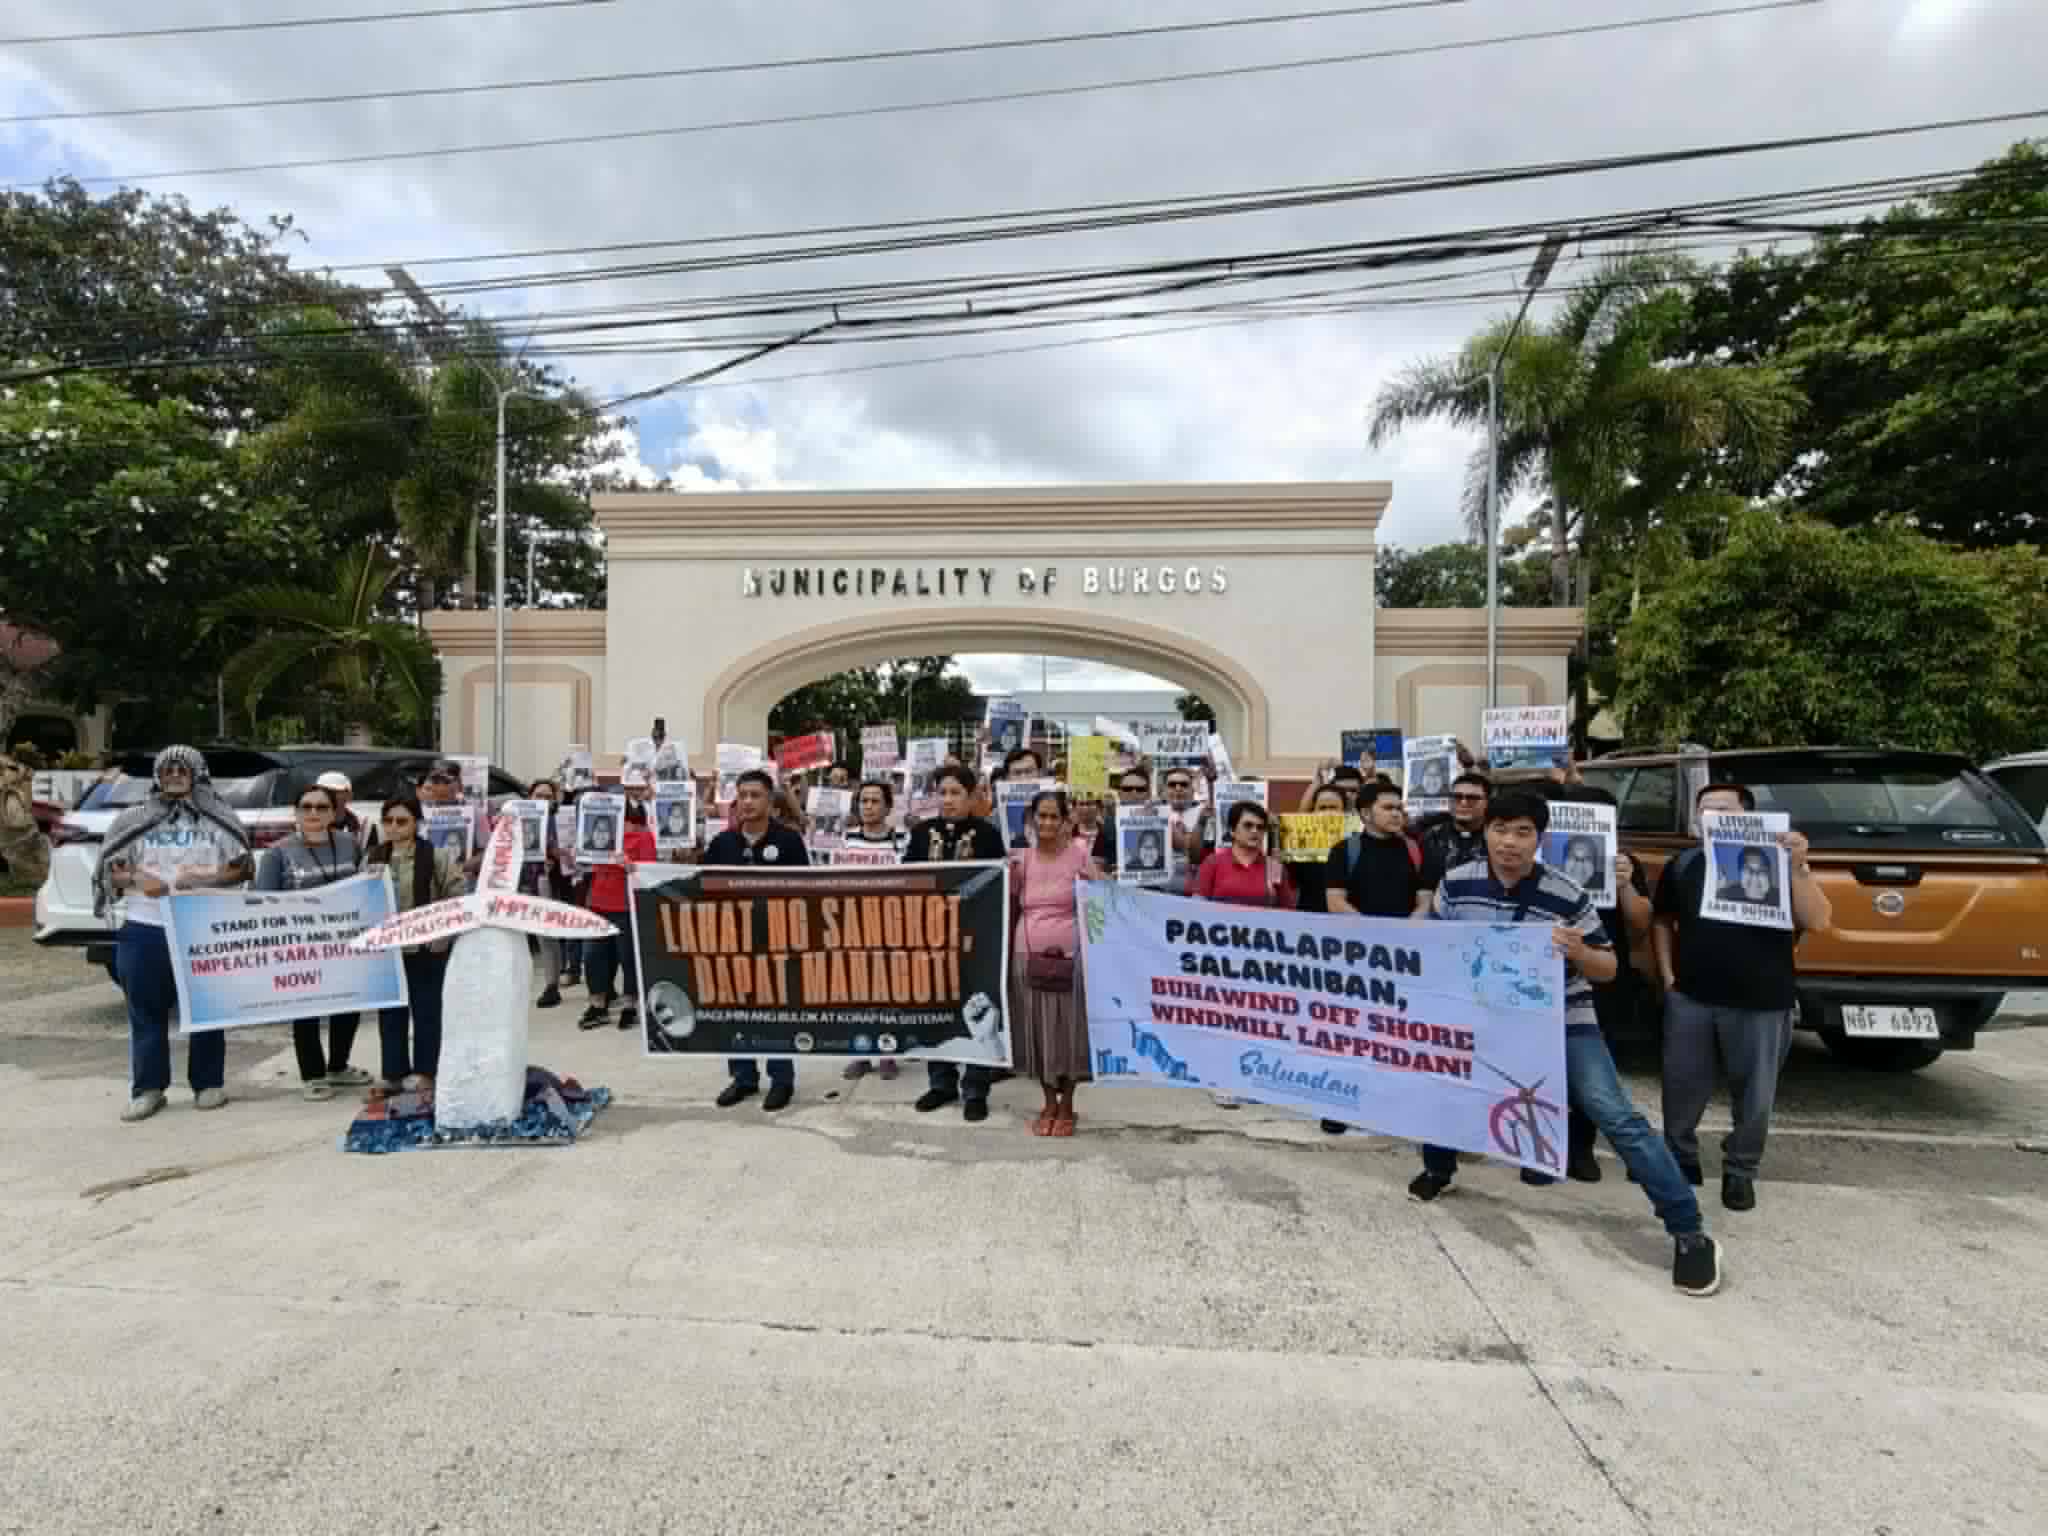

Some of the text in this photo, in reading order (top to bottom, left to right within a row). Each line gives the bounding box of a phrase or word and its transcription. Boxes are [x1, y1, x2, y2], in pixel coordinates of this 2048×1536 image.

[743, 566, 1228, 598] MUNICIPALITY OF BURGOS
[211, 919, 258, 935] STAND
[189, 935, 302, 957] ACCOUNTABILITY
[191, 953, 268, 976] IMPEACH
[273, 946, 319, 963] SARA
[273, 967, 323, 990] NOW!
[1179, 951, 1408, 1011] SALAKNIBAN,
[1151, 976, 1476, 1052] BUHAWIND OFF SHORE
[1151, 1003, 1473, 1081] WINDMILL LAPPEDAN!
